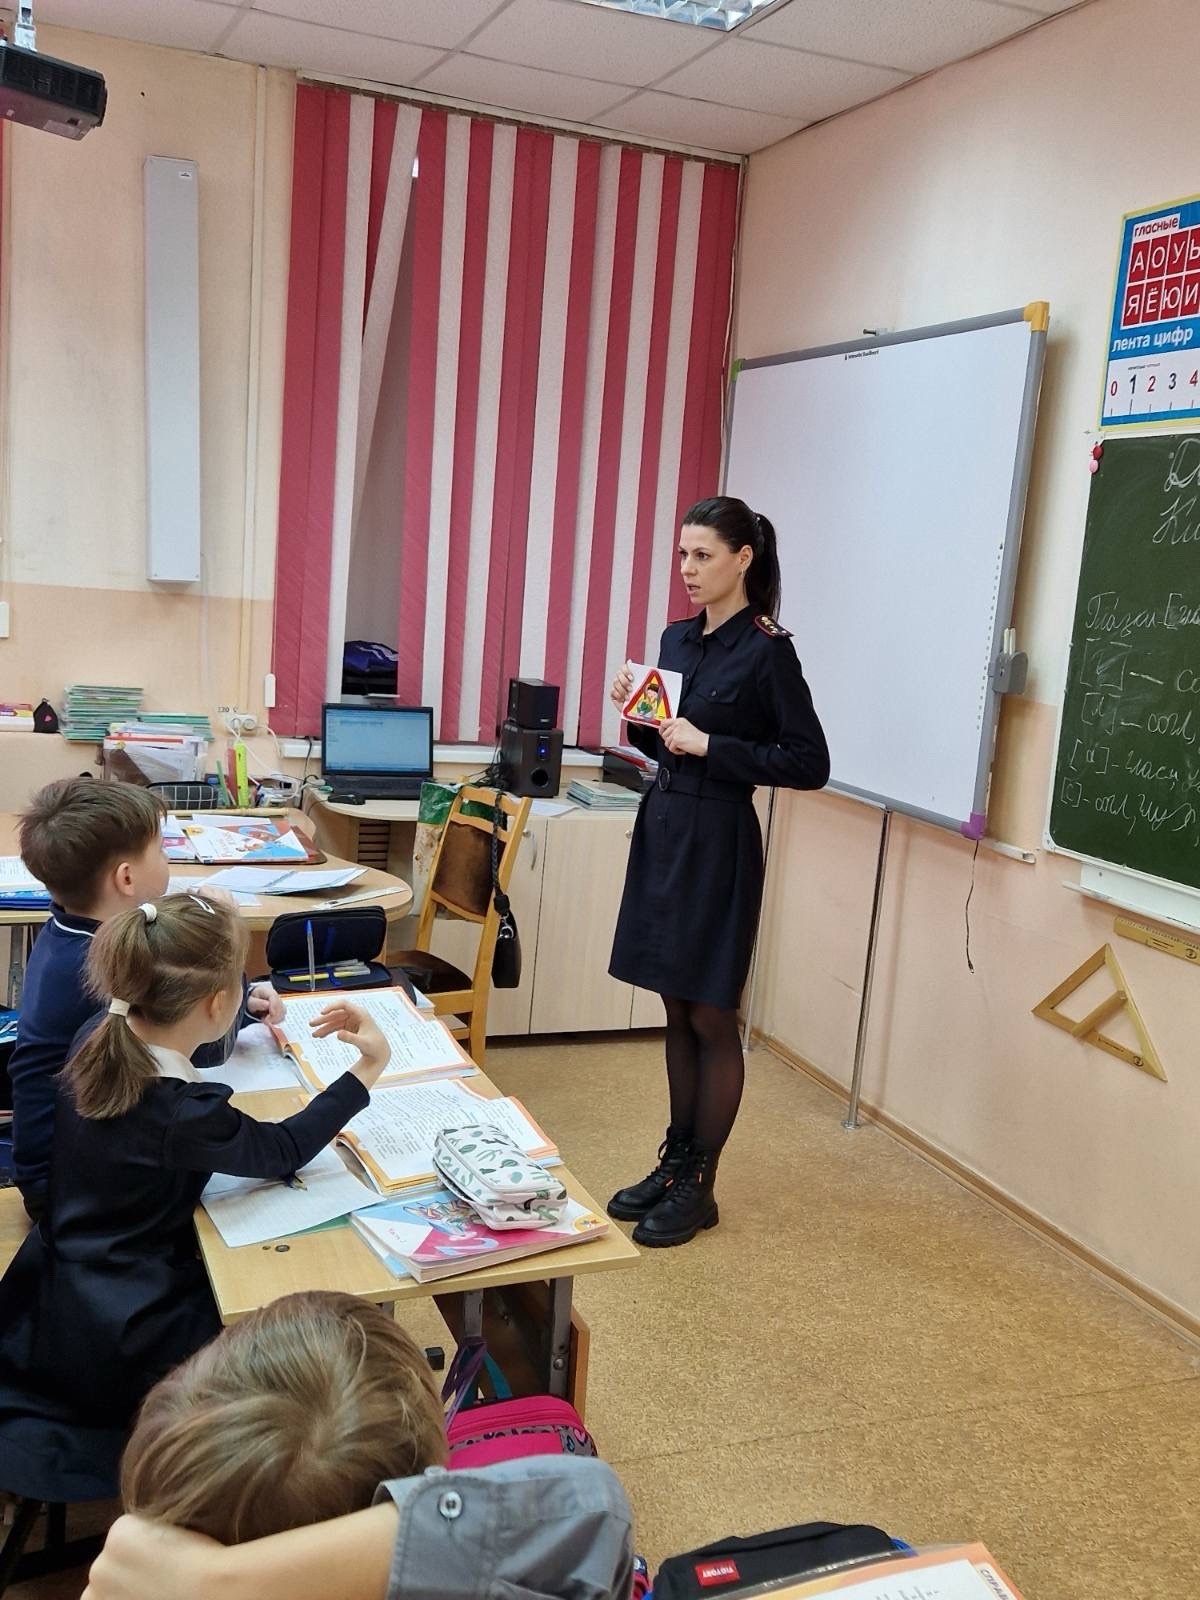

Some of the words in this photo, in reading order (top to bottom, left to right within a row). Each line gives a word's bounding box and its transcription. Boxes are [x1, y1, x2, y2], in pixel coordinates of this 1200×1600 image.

[1134, 217, 1179, 237] гласные
[1131, 250, 1145, 274] А
[1151, 246, 1166, 269] О
[1172, 240, 1186, 265] У
[1125, 294, 1141, 317] Я
[1146, 287, 1159, 314] Ё
[1163, 286, 1181, 310] Ю
[1111, 334, 1151, 353] лента
[1153, 325, 1194, 348] цифр
[1110, 380, 1118, 397] 0
[1129, 373, 1137, 395] 1
[1147, 375, 1156, 393] 2
[1168, 372, 1177, 390] 3
[1189, 368, 1199, 388] 4
